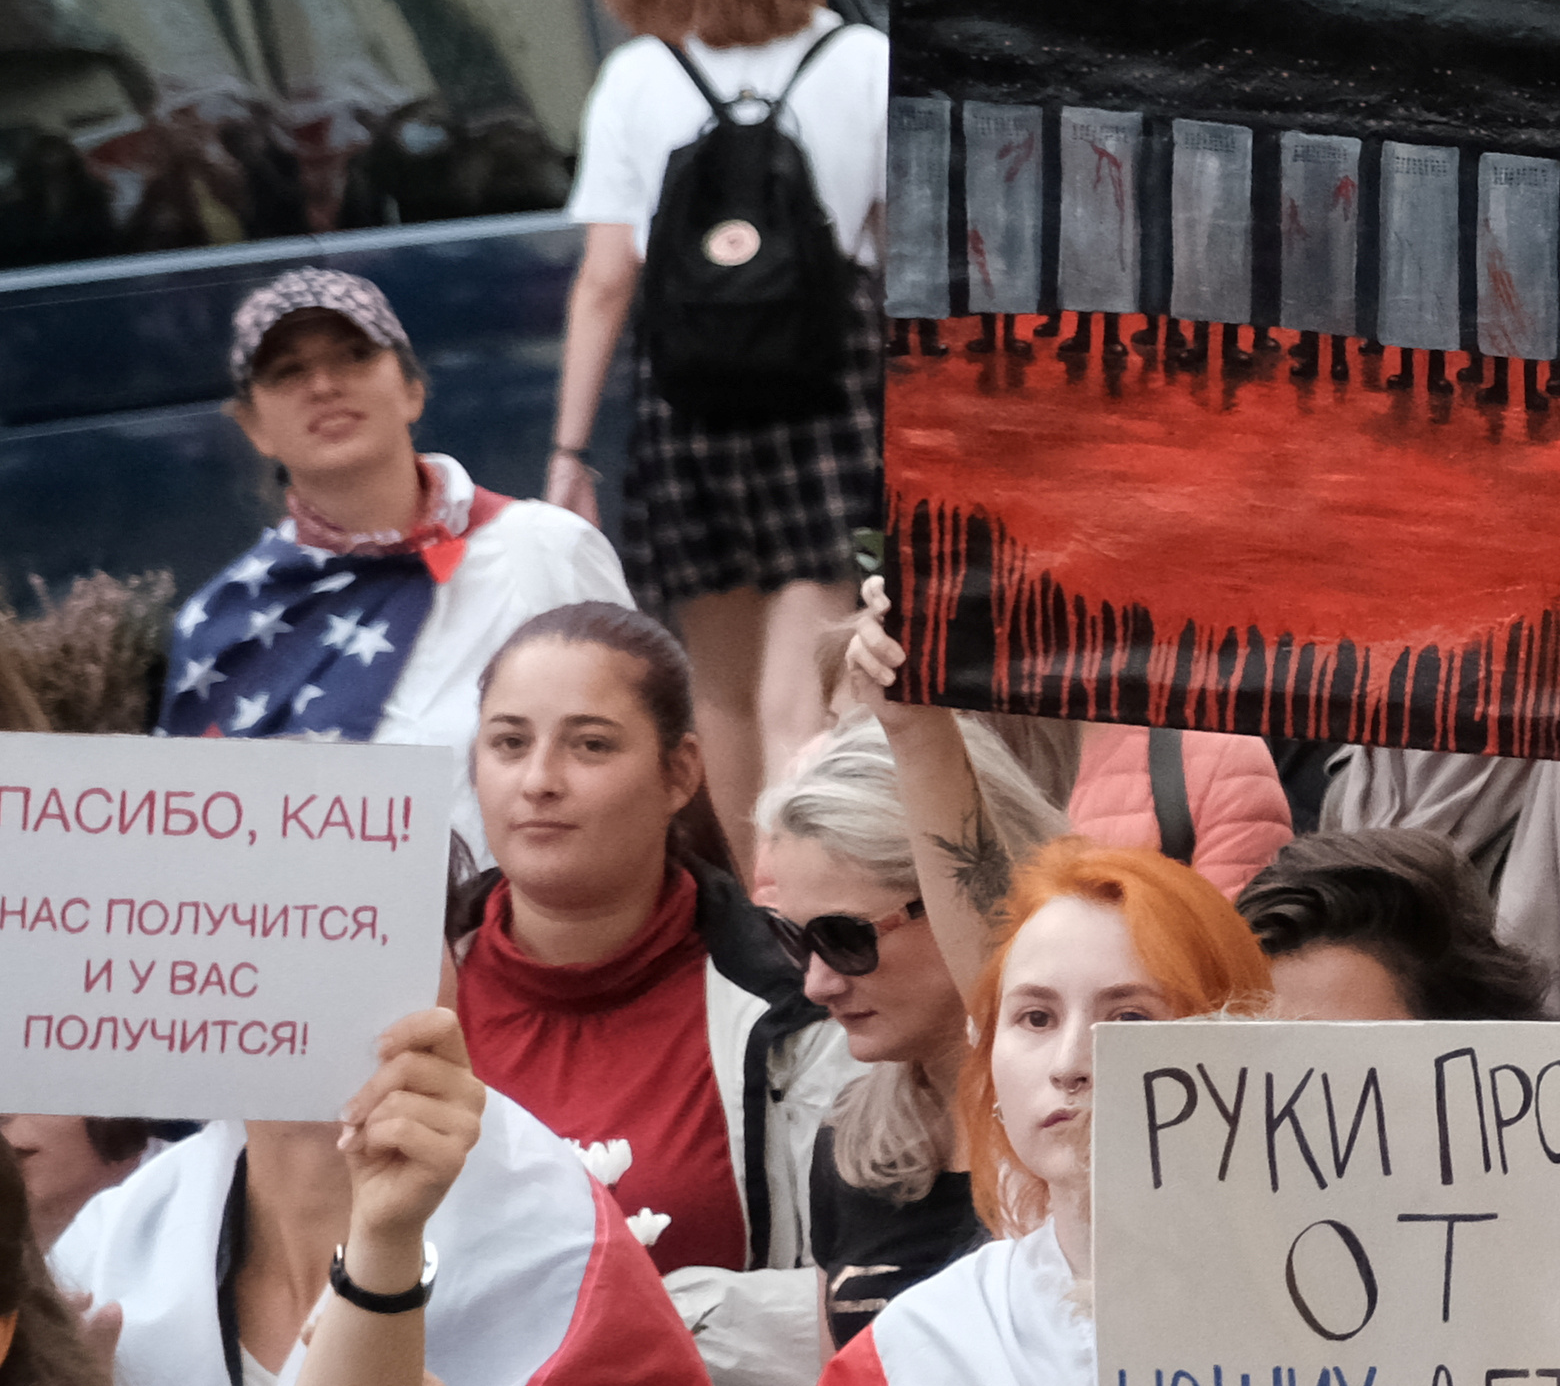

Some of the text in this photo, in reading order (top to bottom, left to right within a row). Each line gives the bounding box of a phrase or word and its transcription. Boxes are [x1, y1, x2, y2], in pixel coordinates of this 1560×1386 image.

[281, 794, 412, 852] КАЦ!
[0, 896, 389, 945] НАС ПОЛУЧИТСЯ,
[84, 958, 258, 998] И У ВАС
[24, 1014, 309, 1056] ПОЛУЧИТСЯ!
[1143, 1062, 1392, 1193] РУКИ
[1285, 1212, 1499, 1342] ОТ
